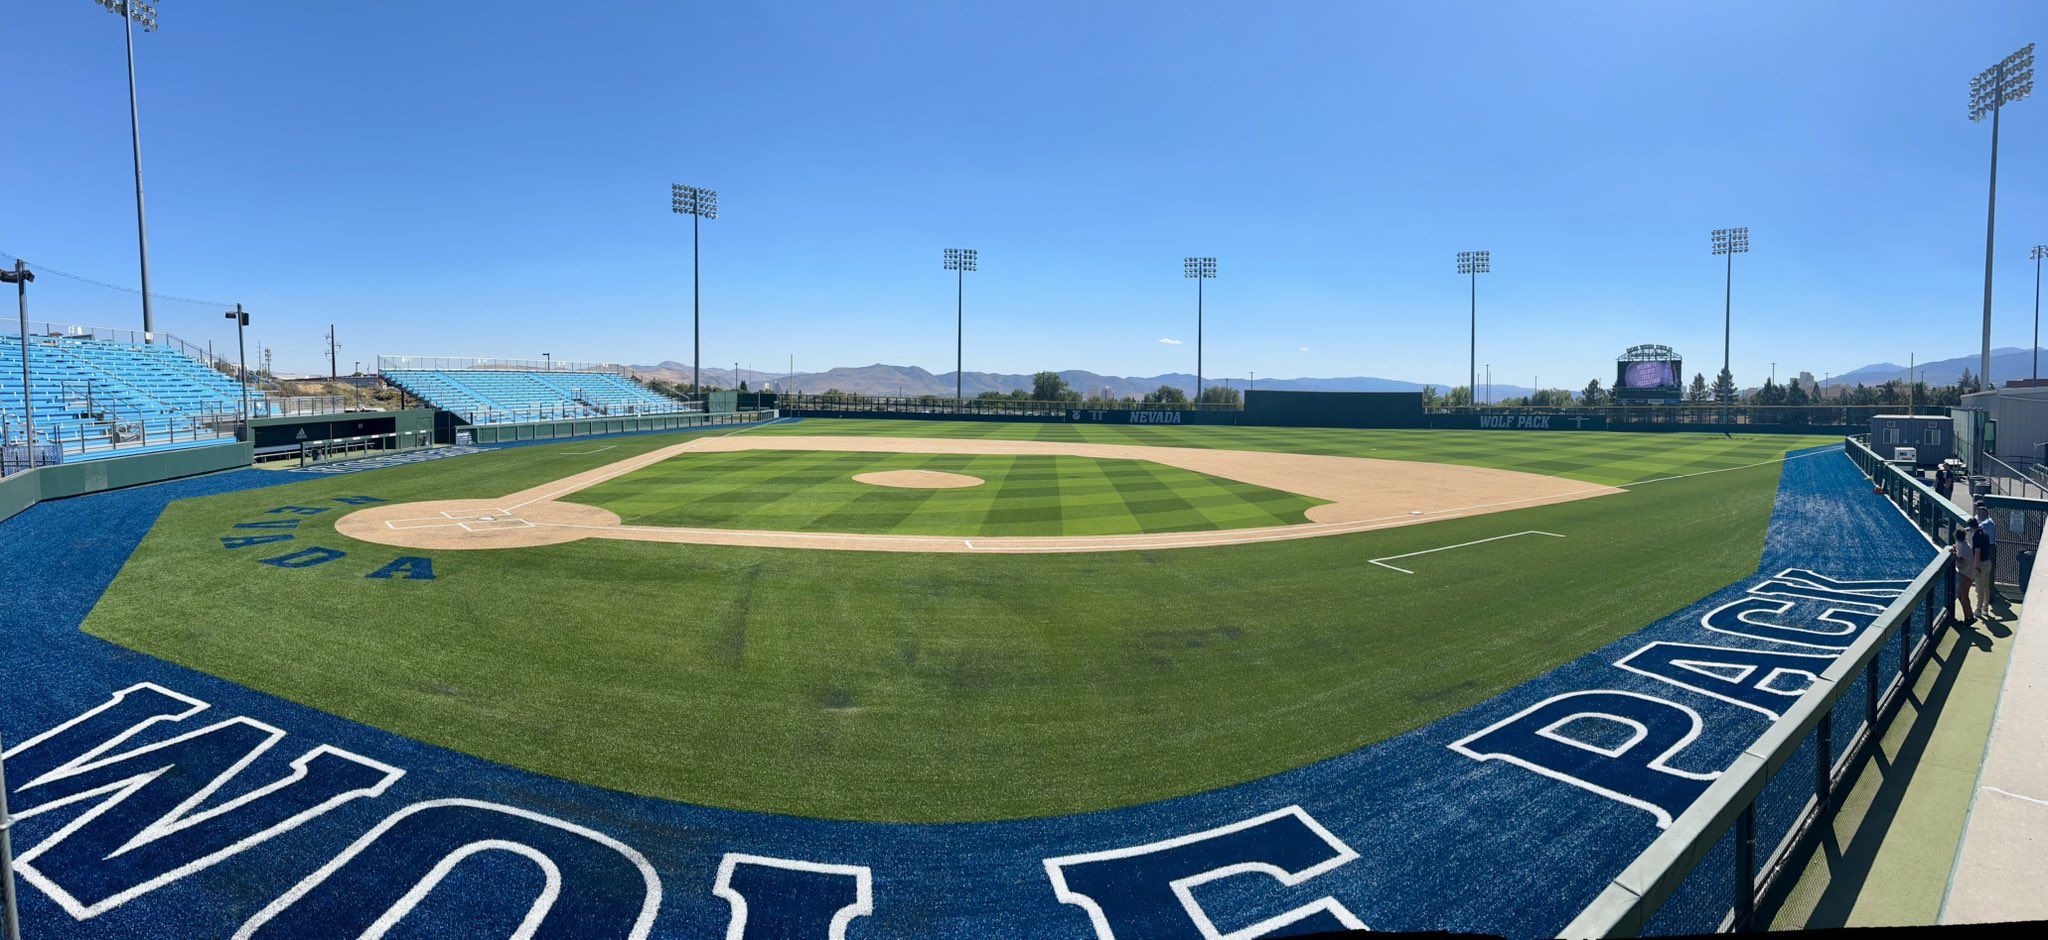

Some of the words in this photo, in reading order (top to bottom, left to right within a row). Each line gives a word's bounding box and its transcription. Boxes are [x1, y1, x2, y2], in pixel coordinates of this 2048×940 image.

[1129, 411, 1181, 424] NEVADA
[1480, 415, 1514, 428] WOLF
[1517, 415, 1550, 428] PACK
[1446, 567, 1915, 831] PACK
